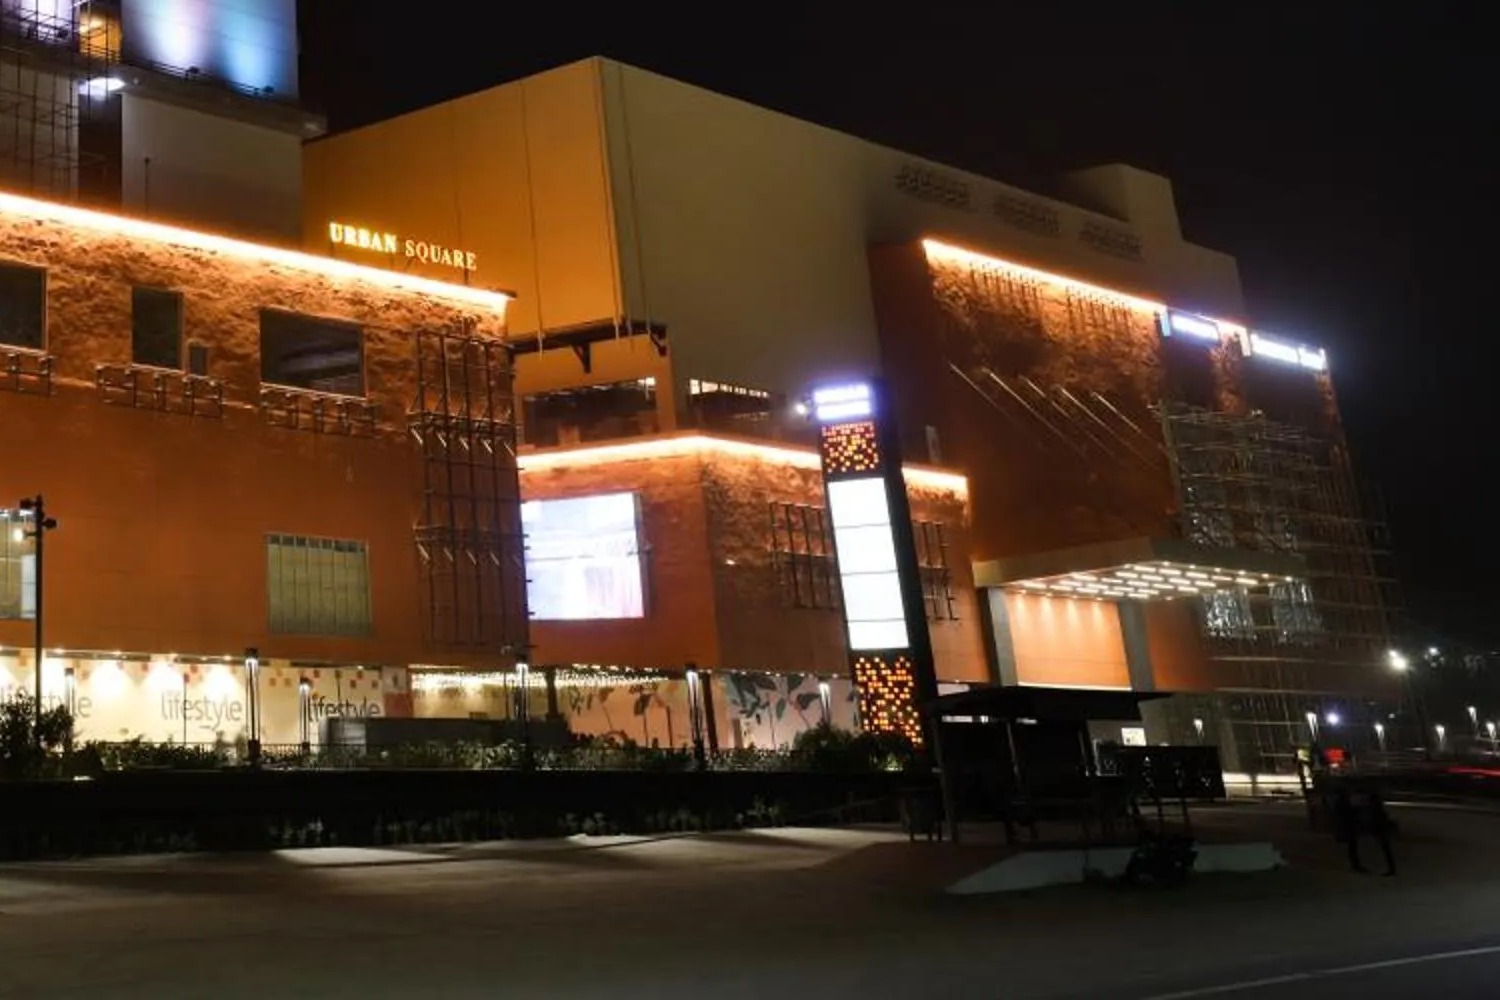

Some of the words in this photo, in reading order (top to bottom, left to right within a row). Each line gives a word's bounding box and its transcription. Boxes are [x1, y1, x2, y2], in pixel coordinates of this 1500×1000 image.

[329, 222, 397, 253] URBAN
[404, 239, 477, 270] SQUARE
[160, 692, 243, 731] lifestyle
[307, 695, 381, 722] lifestyle
